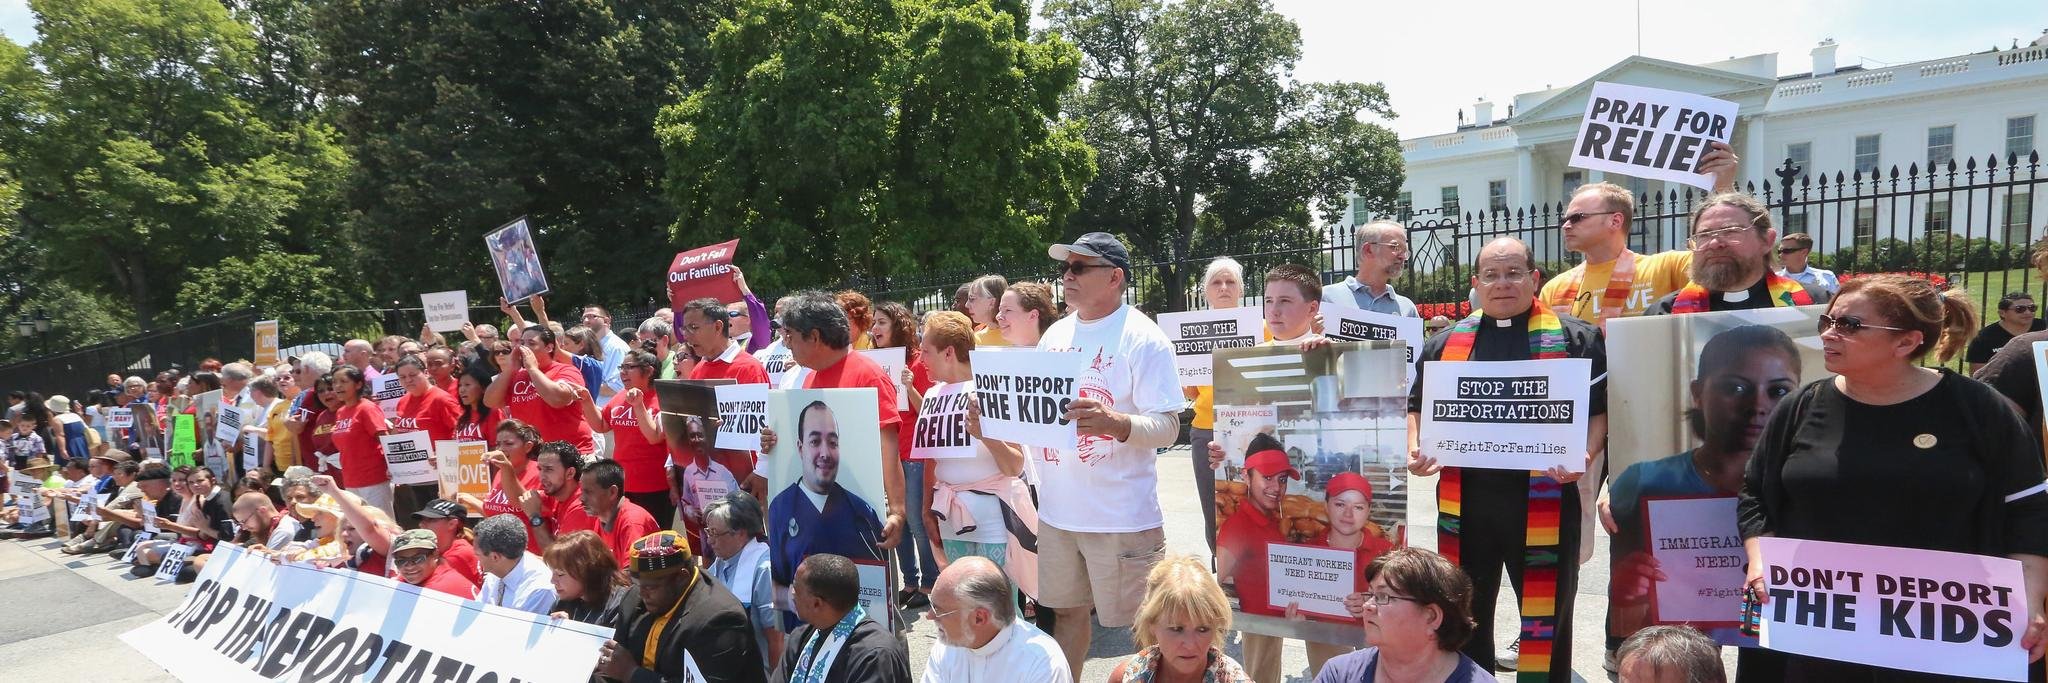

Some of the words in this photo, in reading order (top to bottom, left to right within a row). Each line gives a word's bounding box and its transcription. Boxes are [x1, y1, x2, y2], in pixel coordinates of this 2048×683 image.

[1590, 97, 1669, 128] PRAY
[1674, 108, 1727, 139] FOR
[680, 254, 708, 265] Don't
[707, 248, 727, 260] Fail
[670, 271, 688, 283] Our
[690, 263, 731, 279] Families
[1593, 288, 1654, 313] LVE
[1182, 324, 1210, 336] STOP
[1213, 322, 1237, 334] THE
[1341, 322, 1369, 337] STOP
[1372, 326, 1396, 340] THE
[1173, 338, 1254, 354] EPORTATIONS
[385, 380, 401, 388] STO
[974, 373, 1010, 392] DON'T
[1015, 375, 1074, 395] DEPORT
[1459, 381, 1504, 395] STOP
[1511, 380, 1547, 395] THE
[719, 401, 740, 413] DON'T
[921, 394, 953, 415] PRAY
[952, 392, 969, 411] FO
[977, 391, 1011, 421] THE
[1017, 394, 1072, 426] KIDS
[1434, 403, 1571, 419] DEPORTATIONS
[1437, 440, 1567, 454] #FightForFamilies
[458, 463, 487, 485] OVE
[1659, 536, 1744, 550] IMMIGRAN
[169, 549, 185, 560] PRA
[1270, 554, 1314, 567] IMMIGRANT
[1316, 558, 1353, 570] WORKERS
[1695, 556, 1741, 568] NEED
[1285, 568, 1306, 578] NEED
[1308, 570, 1340, 582] RELIEF
[1769, 565, 1863, 592] DON'T
[1876, 574, 2012, 607] DEPORT
[168, 579, 239, 640] STOP
[1769, 588, 1857, 632] THE
[1879, 598, 2014, 648] KIDS
